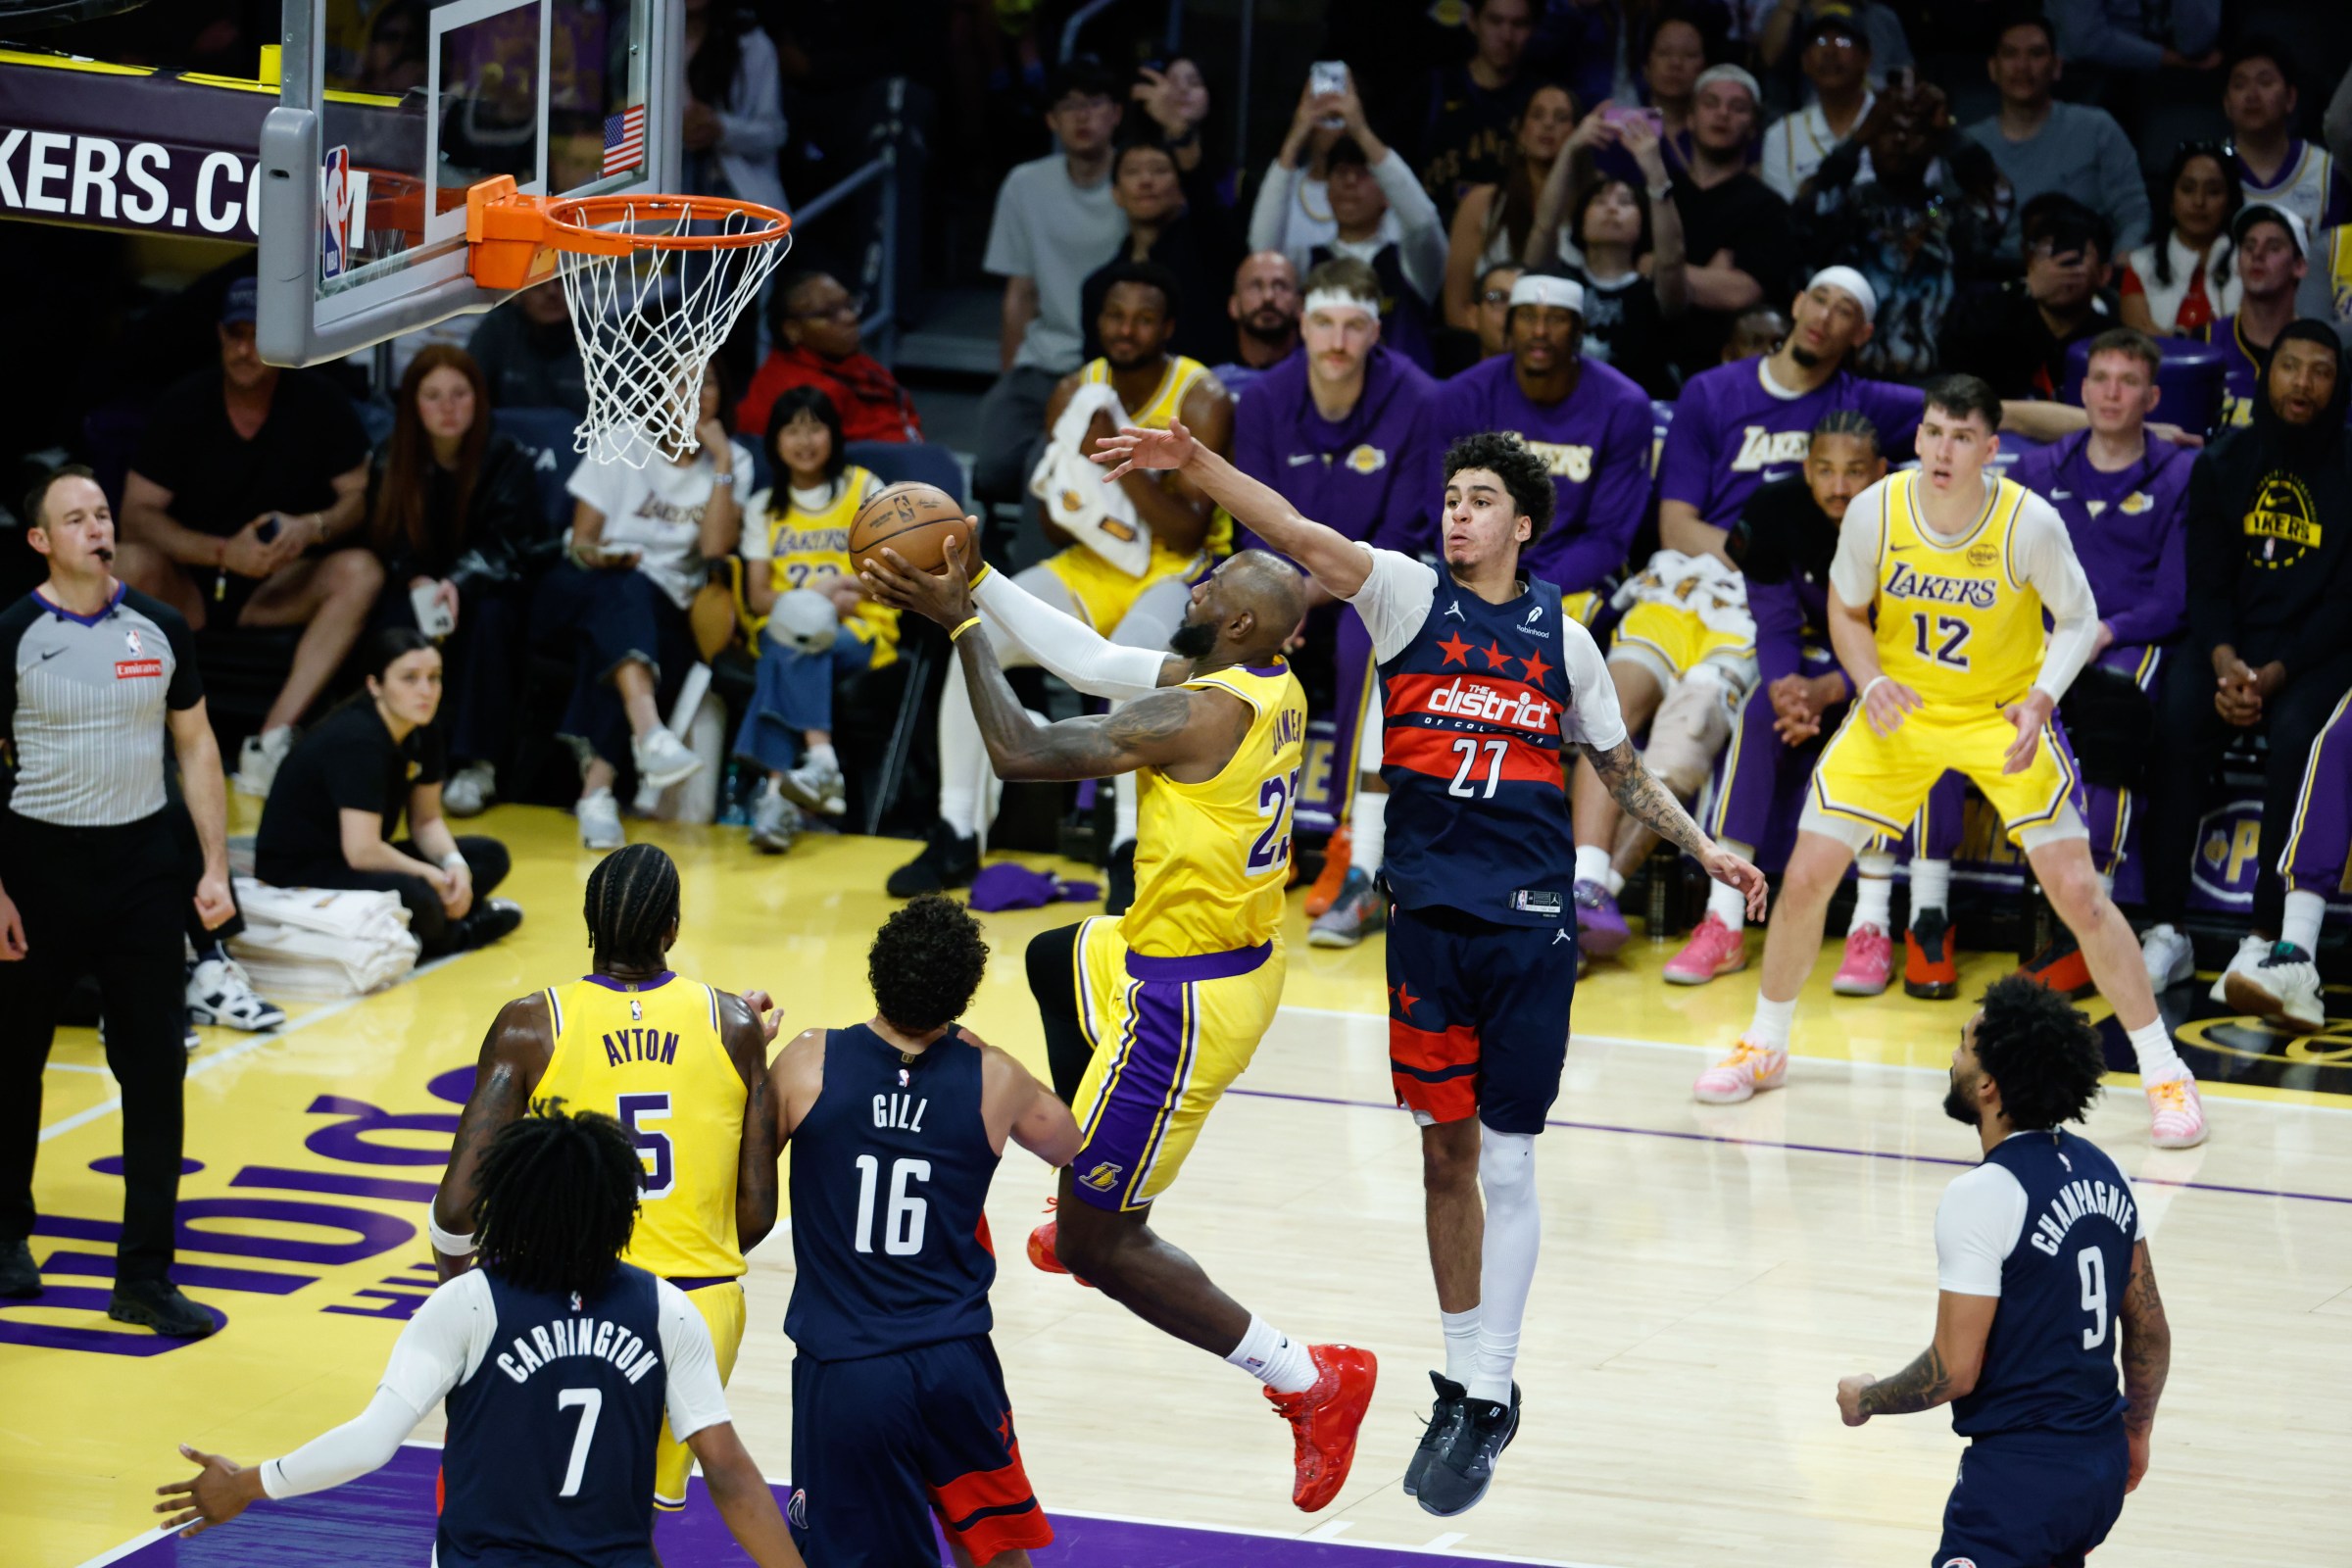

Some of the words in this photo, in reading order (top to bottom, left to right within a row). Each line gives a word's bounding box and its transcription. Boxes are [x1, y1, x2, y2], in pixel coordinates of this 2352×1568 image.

[1732, 425, 1810, 471] LAKE
[1885, 562, 1996, 609] LAKERS
[1516, 624, 1549, 638] Robinhood
[1914, 612, 1970, 673] 12
[118, 662, 162, 675] Emirates
[1469, 684, 1490, 695] THE
[1427, 676, 1551, 730] district
[1272, 709, 1302, 756] JAMES
[1424, 716, 1443, 726] OF
[1454, 721, 1544, 744] COLIA
[1448, 738, 1509, 799] 27
[603, 1028, 679, 1066] AYTON
[873, 1095, 928, 1133] GILL
[617, 1092, 674, 1200] 5
[855, 1154, 932, 1255] 16
[2031, 1178, 2136, 1257] CHAMPAGNIE
[2078, 1246, 2108, 1349] 9
[496, 1317, 661, 1385] CARRINGTON
[557, 1388, 603, 1496] 7
